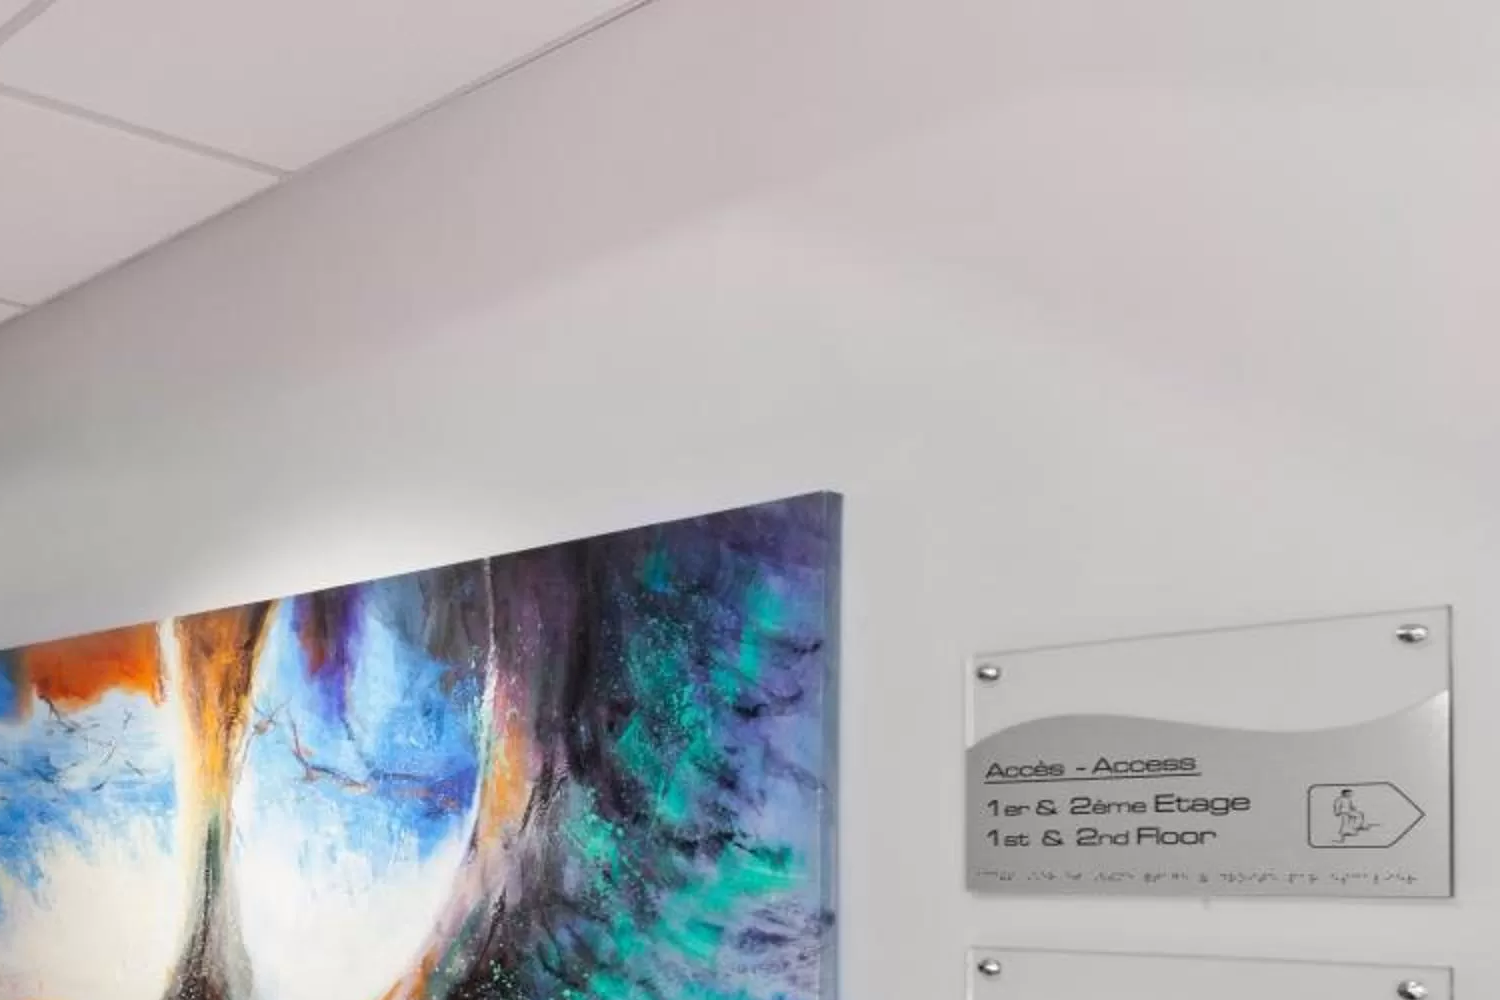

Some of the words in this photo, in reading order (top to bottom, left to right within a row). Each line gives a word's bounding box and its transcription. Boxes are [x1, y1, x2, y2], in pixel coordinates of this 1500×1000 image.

[985, 759, 1065, 780] Accès
[1092, 755, 1197, 776] Access
[987, 799, 1030, 817] 1er
[1036, 798, 1058, 816] &
[1070, 796, 1147, 816] 2ème
[1154, 793, 1252, 815] Etage
[987, 829, 1030, 848] 1st
[1042, 829, 1064, 848] &
[1076, 828, 1129, 847] 2nd
[1137, 827, 1217, 847] Floor
